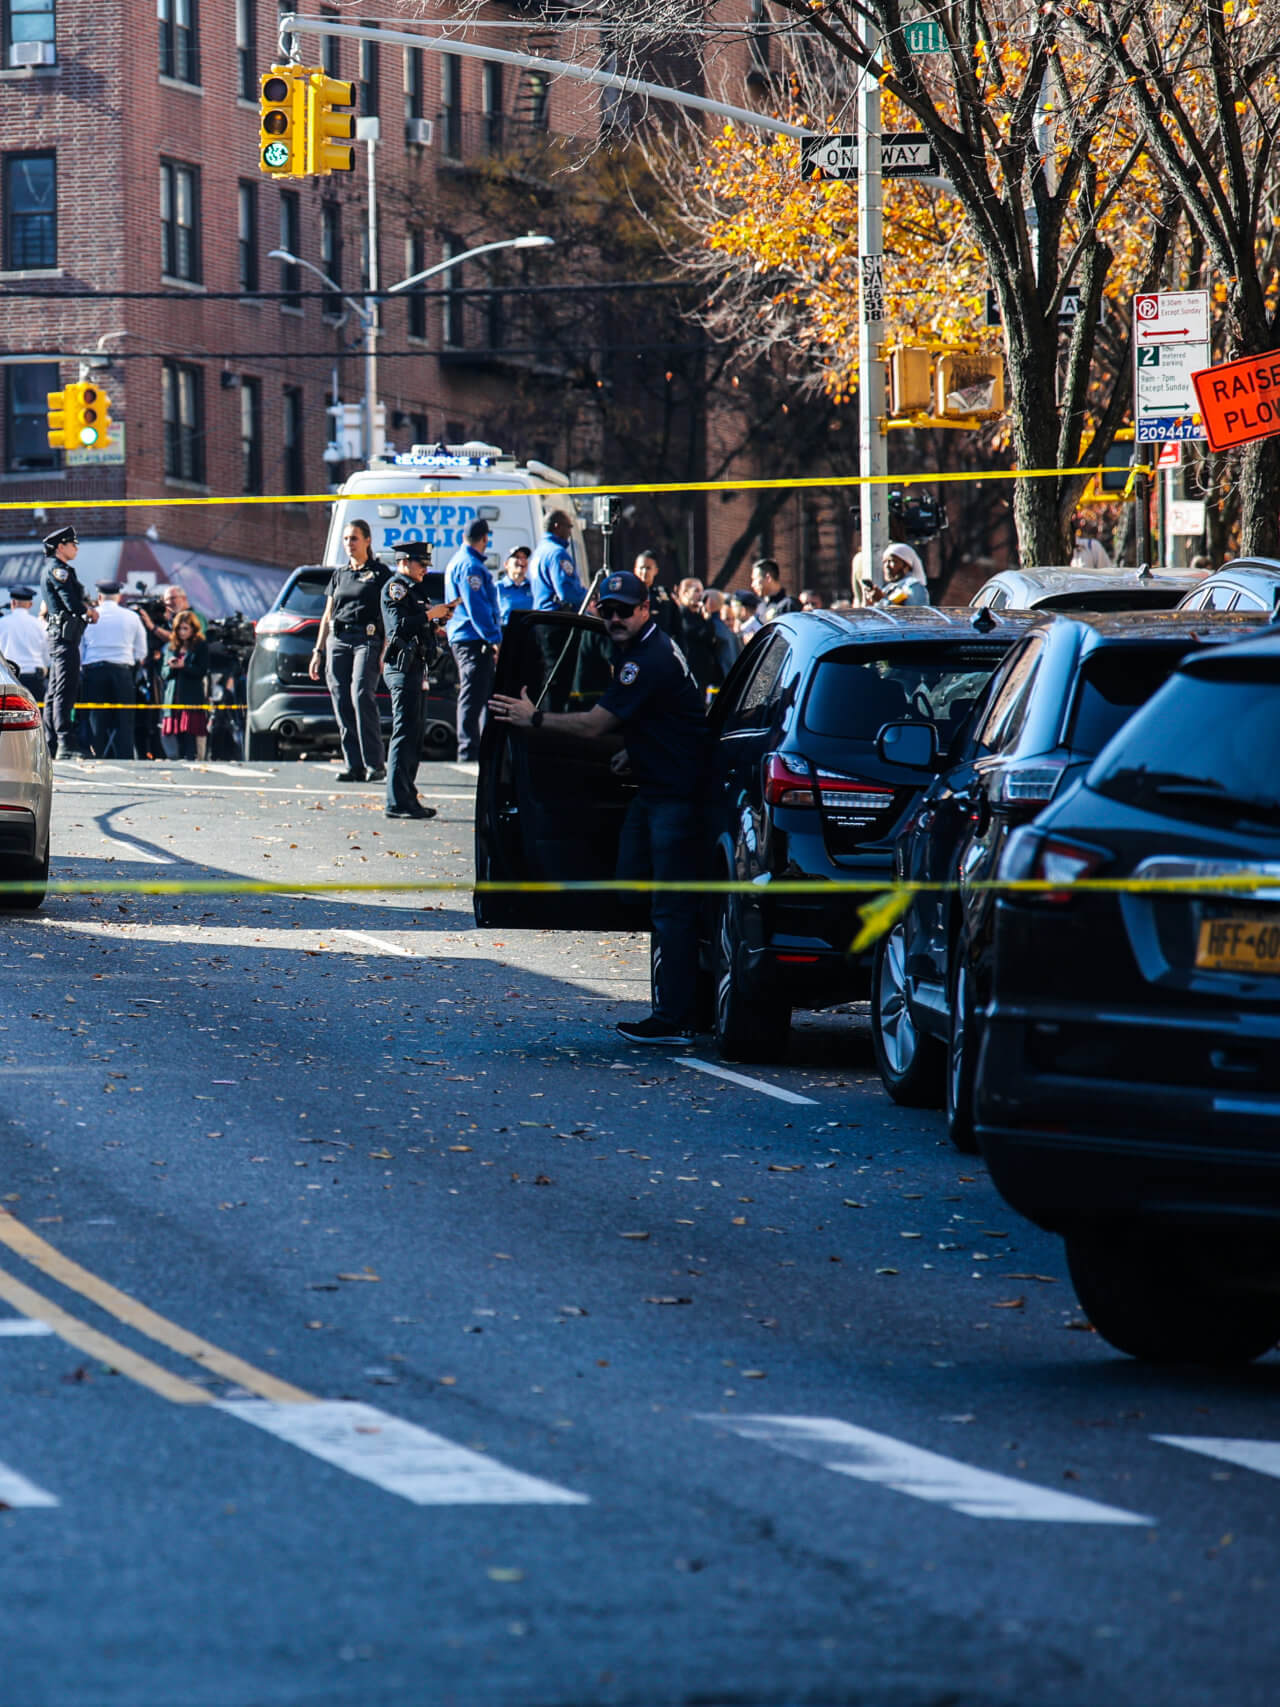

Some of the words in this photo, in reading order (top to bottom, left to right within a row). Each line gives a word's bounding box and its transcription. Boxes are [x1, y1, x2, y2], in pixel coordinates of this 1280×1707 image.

[827, 149, 854, 166] ON
[881, 146, 921, 164] WAY
[1142, 347, 1155, 365] 2
[1141, 384, 1164, 393] Except
[1165, 383, 1190, 392] Sunday
[400, 504, 476, 525] NYPD
